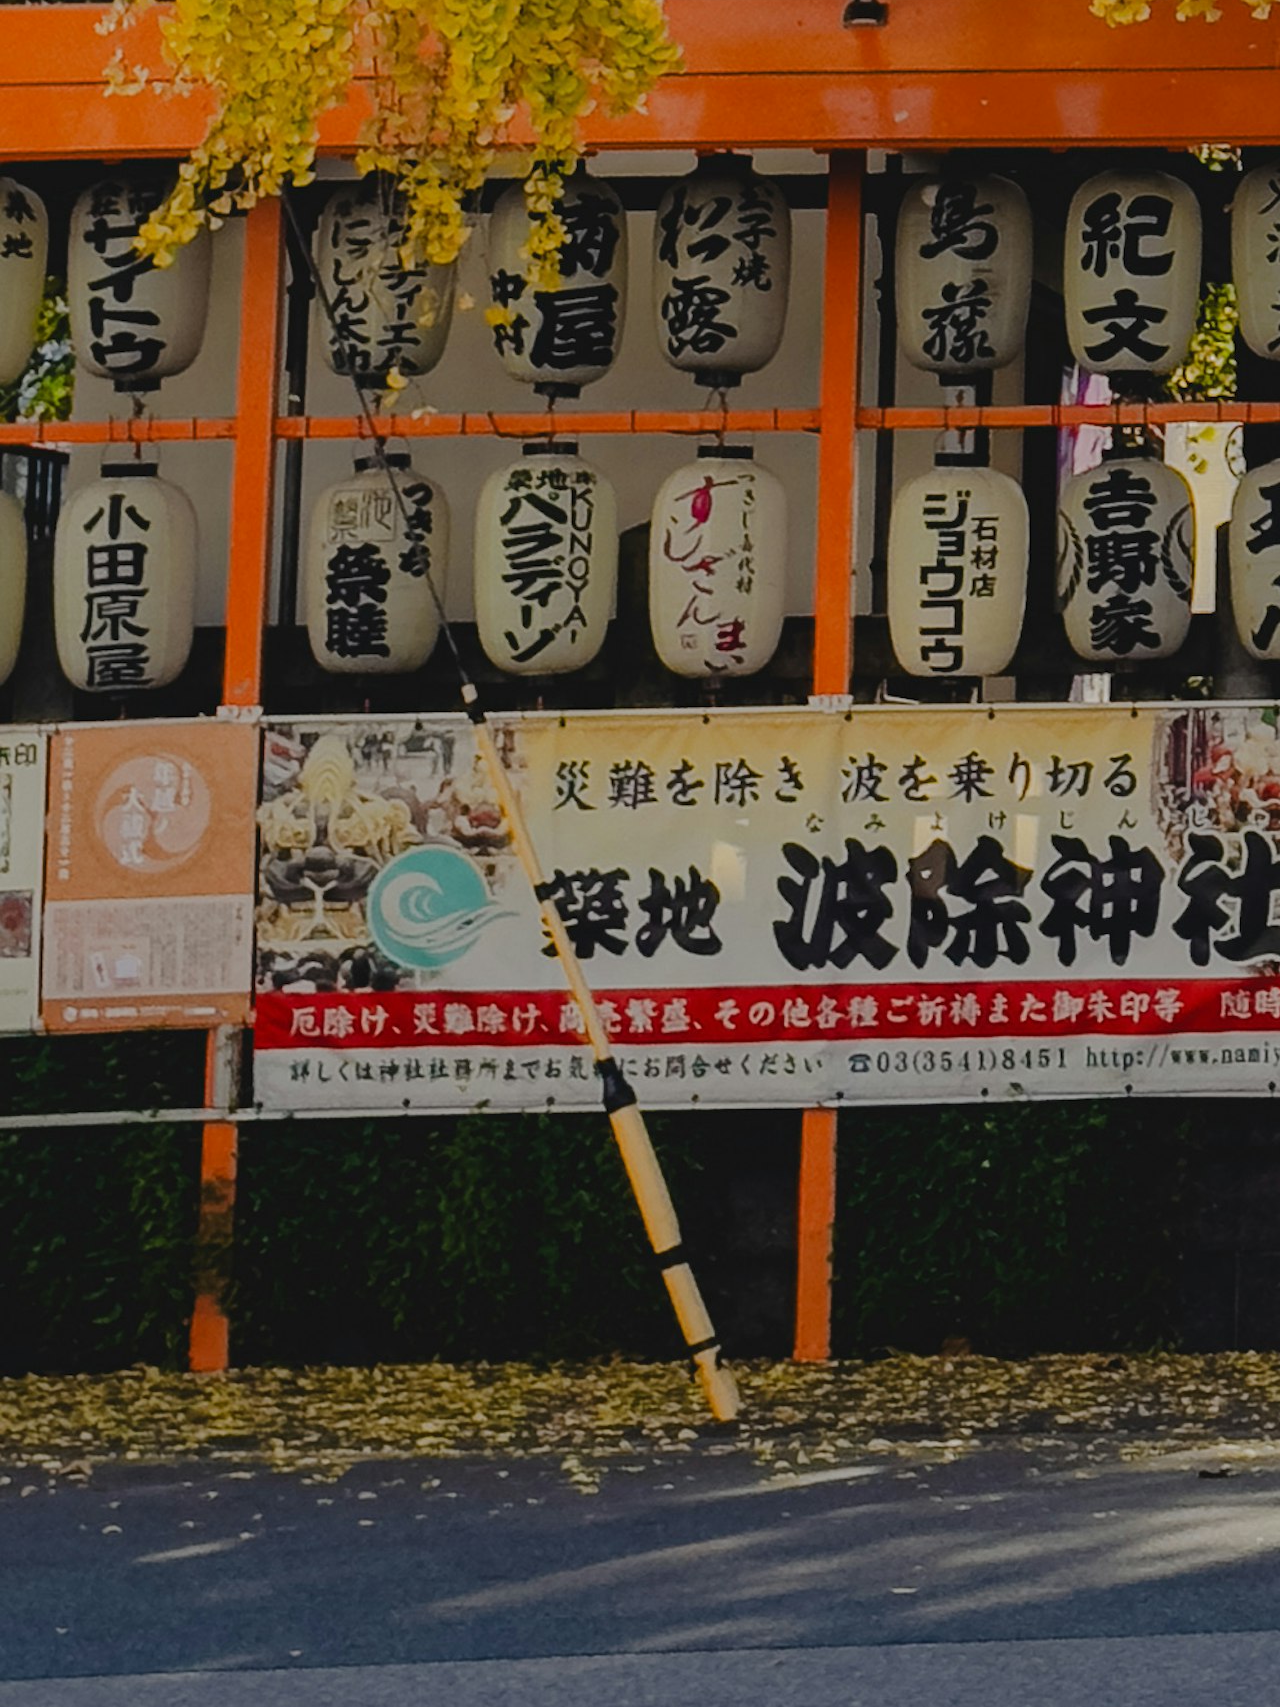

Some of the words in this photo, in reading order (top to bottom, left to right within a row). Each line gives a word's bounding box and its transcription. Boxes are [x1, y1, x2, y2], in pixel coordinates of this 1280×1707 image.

[1081, 192, 1175, 363] 紀文
[80, 492, 153, 686] 小田原屋
[919, 489, 971, 672] ジョウコウ
[968, 515, 999, 599] 石材店
[1086, 469, 1161, 654] 吉野家
[553, 755, 805, 811] 災難を除き
[840, 751, 1138, 804] 波を乗り切る
[535, 864, 722, 959] 築地
